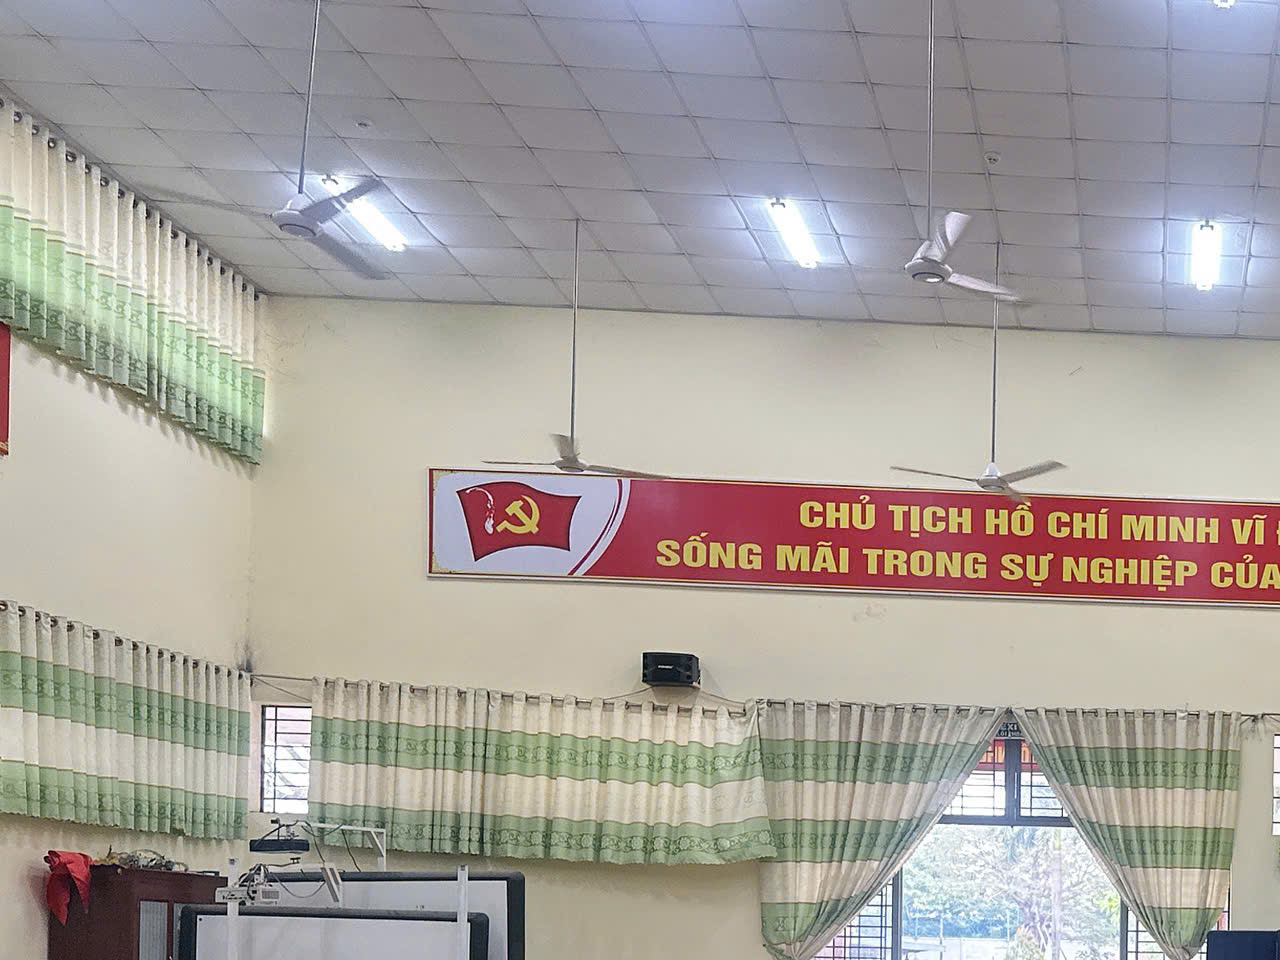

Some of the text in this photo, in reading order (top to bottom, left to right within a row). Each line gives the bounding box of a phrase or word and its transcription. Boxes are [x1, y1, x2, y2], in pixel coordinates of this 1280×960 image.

[799, 494, 875, 530] CHỦ
[887, 504, 972, 537] TỊCH
[985, 502, 1034, 537] HỒ
[1047, 508, 1109, 539] CHÍ
[1121, 514, 1219, 543] MINH
[1231, 514, 1268, 545] VĨ
[655, 530, 762, 570] SỐNG
[776, 541, 850, 574] MÃI
[862, 548, 988, 579] TRONG
[1000, 552, 1054, 587] SỰ
[1062, 554, 1198, 591] NGHIỆP
